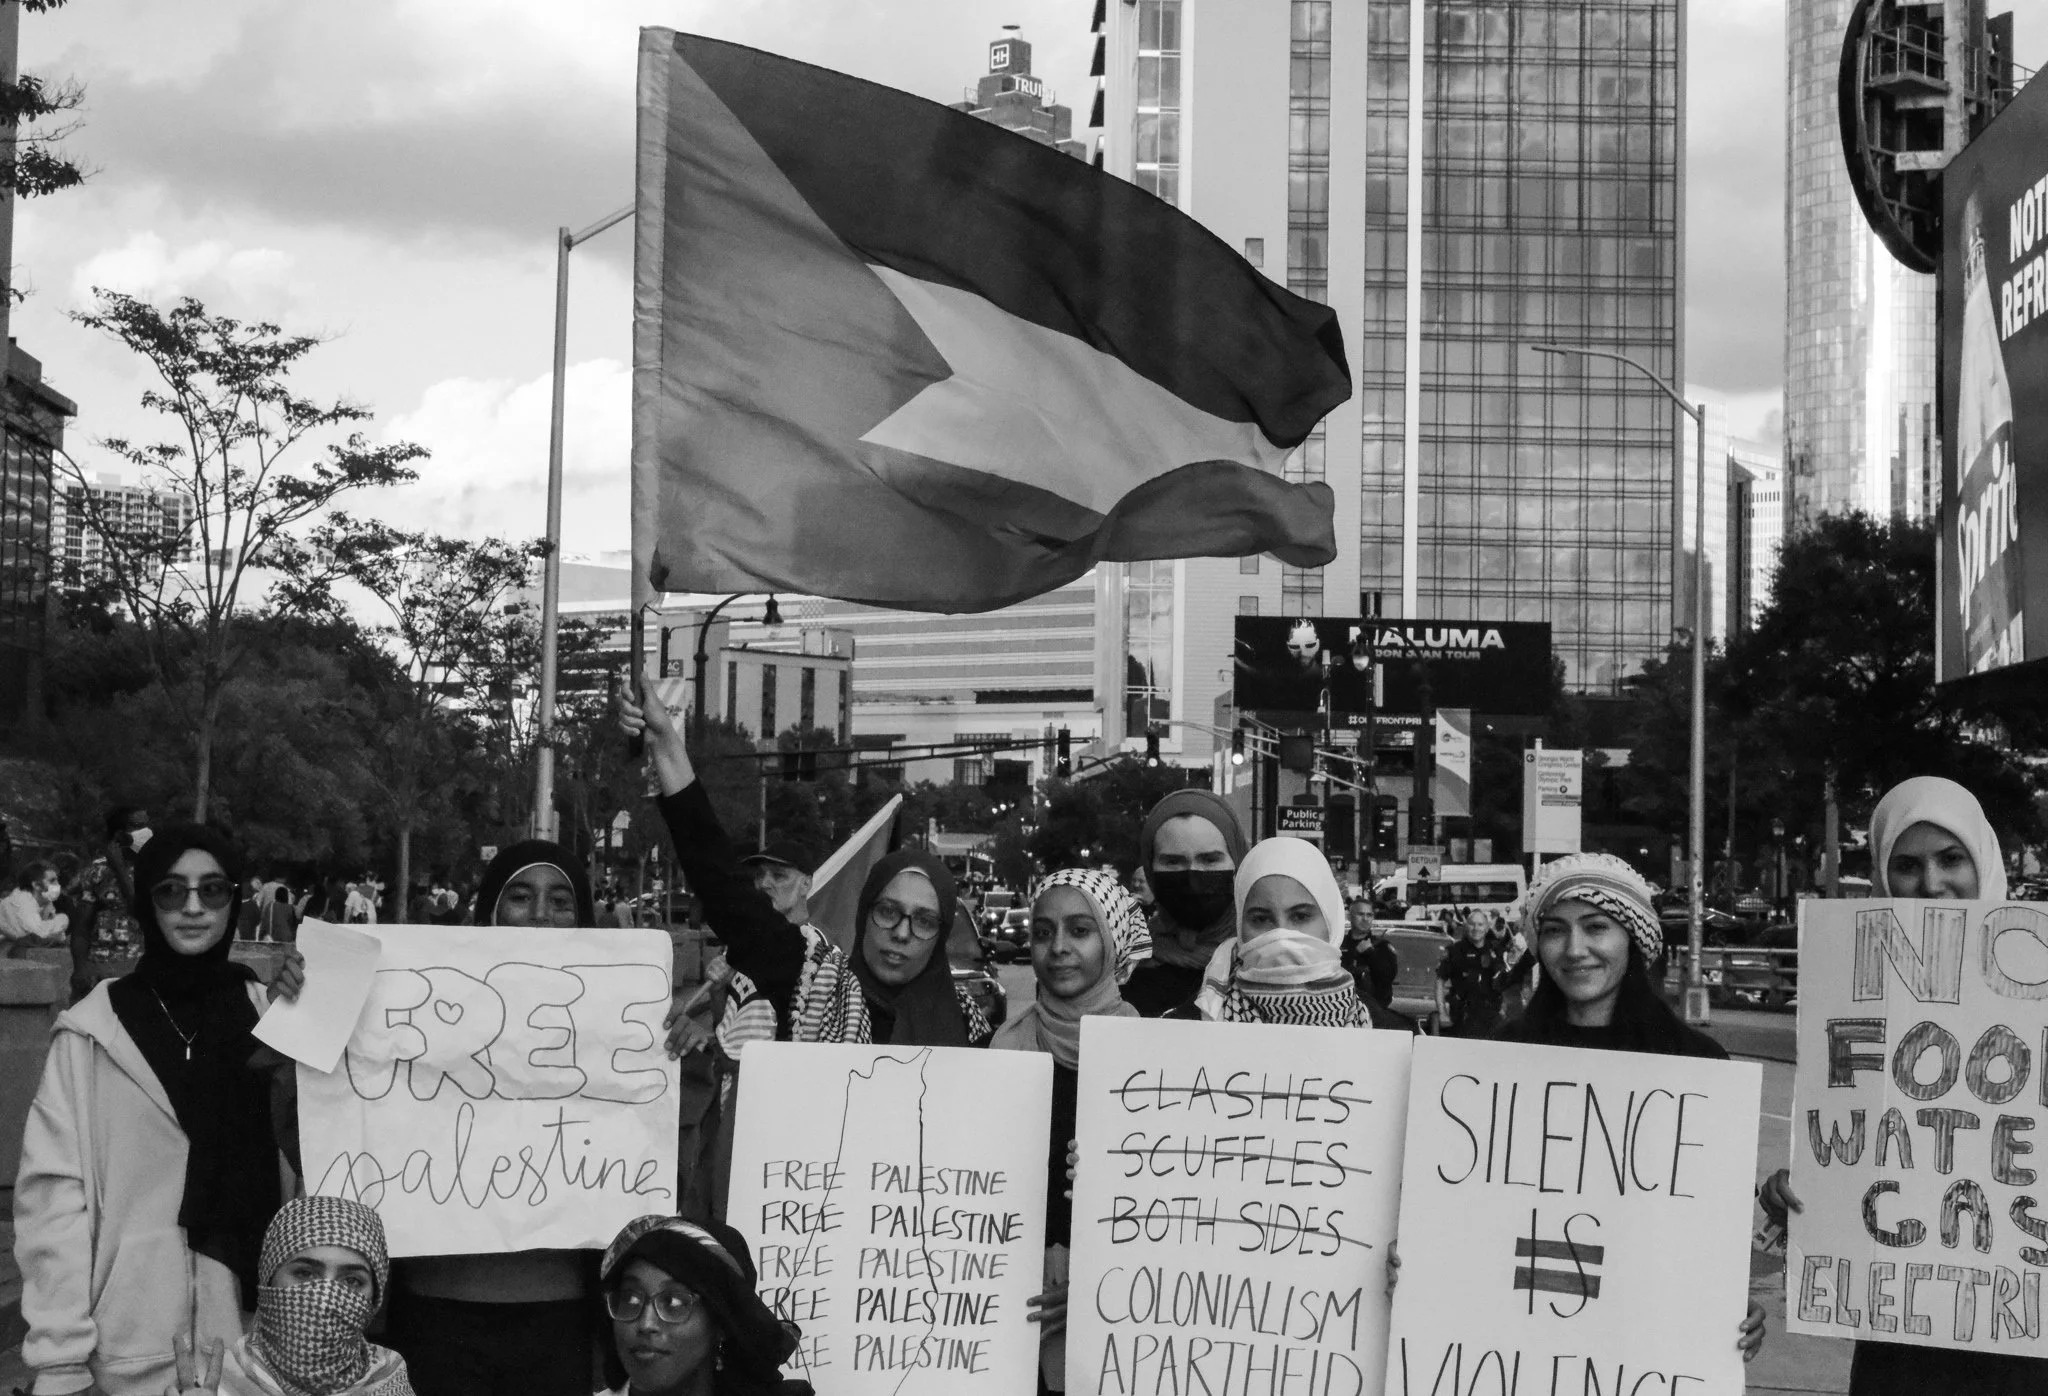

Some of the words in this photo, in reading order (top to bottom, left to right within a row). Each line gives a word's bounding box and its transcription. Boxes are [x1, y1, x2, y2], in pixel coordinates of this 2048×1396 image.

[2010, 173, 2048, 264] NOT
[2002, 248, 2048, 342] REFR
[1958, 440, 2018, 631] Sprite
[1375, 649, 1402, 658] DON
[1445, 650, 1481, 659] TOUR
[1282, 819, 1321, 831] Parking
[1287, 809, 1318, 819] Public
[1410, 856, 1438, 864] DETOUR
[1825, 1018, 2048, 1107] FOO
[1121, 1066, 1354, 1124] CLASHES
[313, 1102, 671, 1210] palestine
[1120, 1132, 1349, 1187] SCUFFLES
[1437, 1074, 1708, 1198] SILENCE
[763, 1160, 846, 1191] FREE
[871, 1162, 1007, 1195] PALESTINE
[762, 1200, 845, 1235] FREE
[871, 1204, 1024, 1244] PALESTINE
[1111, 1196, 1218, 1245] BOTH
[1238, 1201, 1344, 1257] SIDES
[1861, 1179, 2048, 1267] GAS
[759, 1244, 834, 1281] FREE
[858, 1247, 1008, 1284] PALESTINE
[1528, 1208, 1600, 1318] IS
[855, 1287, 999, 1326] PALESTINE
[1096, 1266, 1363, 1351] COLONIALISM
[853, 1334, 991, 1374] PALESTINE
[1098, 1332, 1363, 1396] APARTHEID
